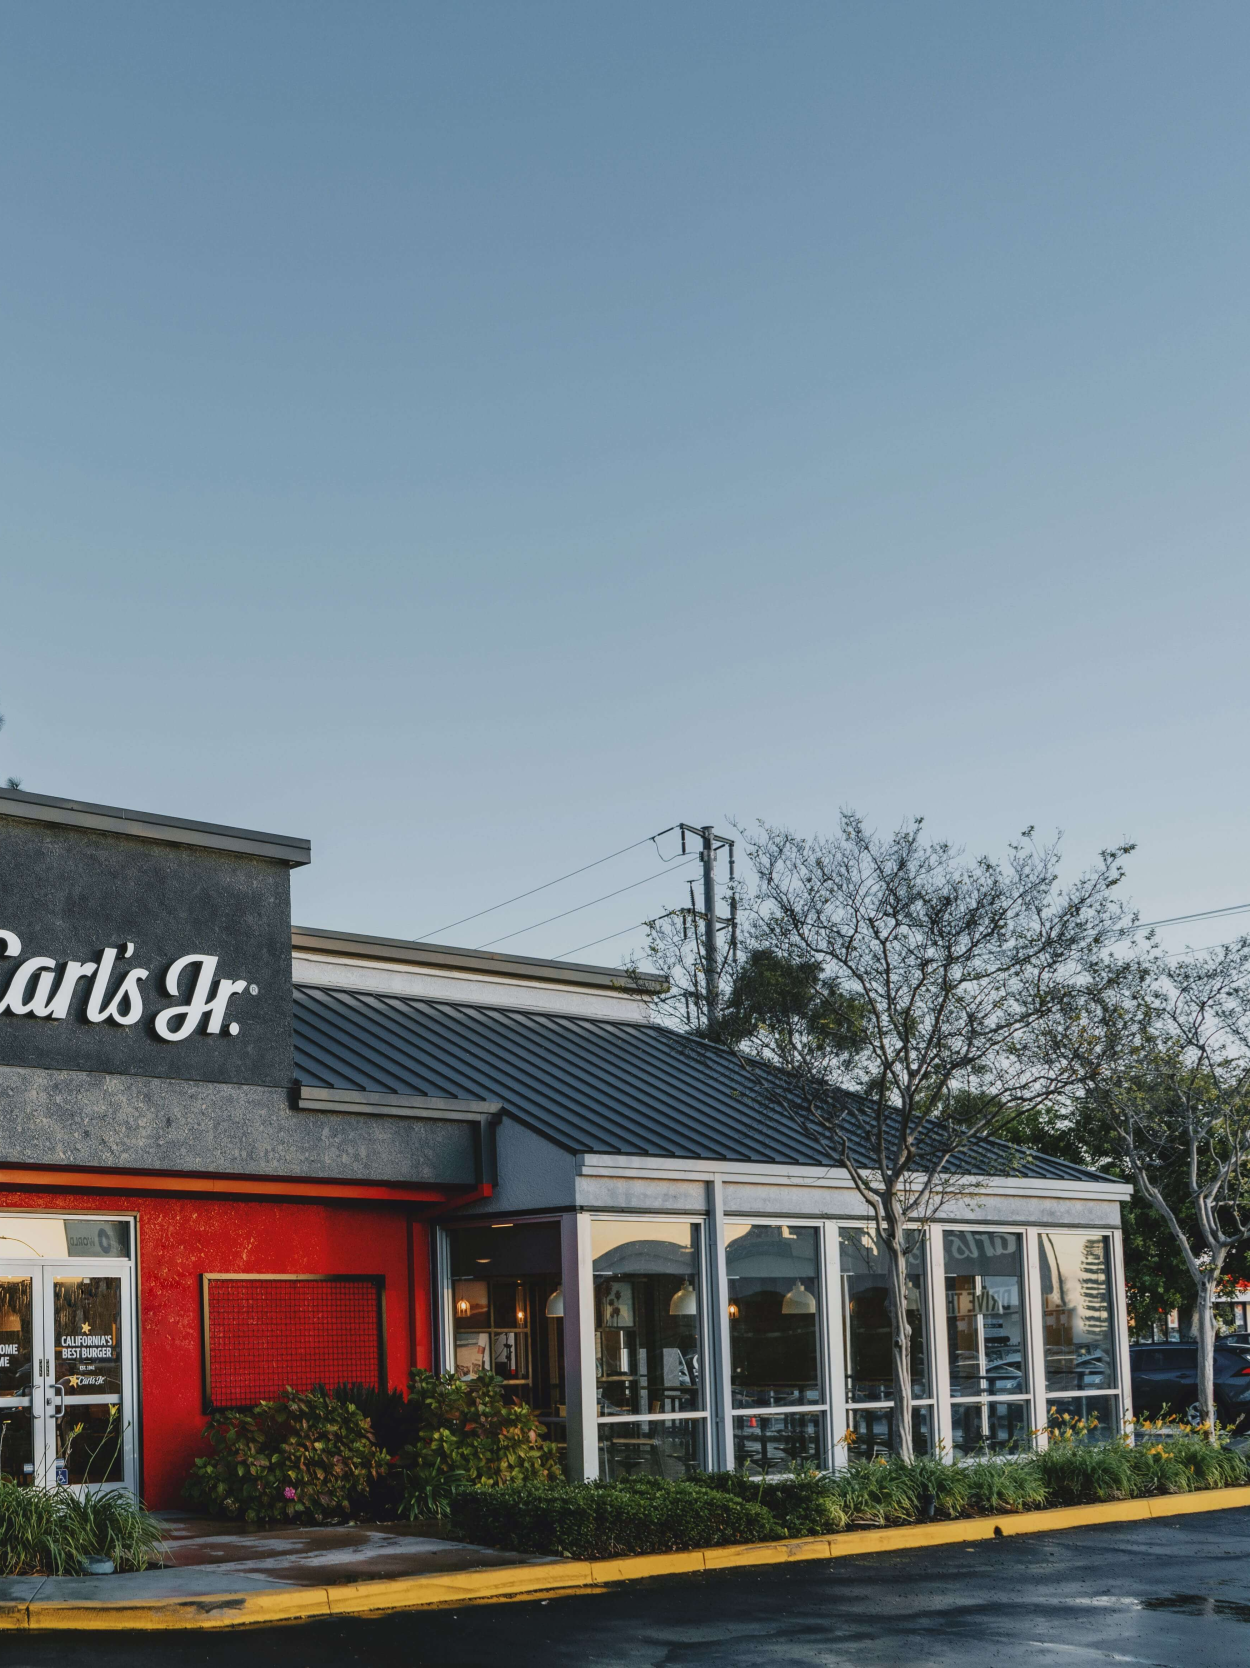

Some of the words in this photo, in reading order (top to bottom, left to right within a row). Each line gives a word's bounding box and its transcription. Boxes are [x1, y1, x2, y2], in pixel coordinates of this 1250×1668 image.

[154, 954, 248, 1042] Jr.
[61, 1335, 113, 1347] CALIFORNIA'S
[62, 1348, 81, 1359] BEST
[81, 1347, 112, 1358] BURGER
